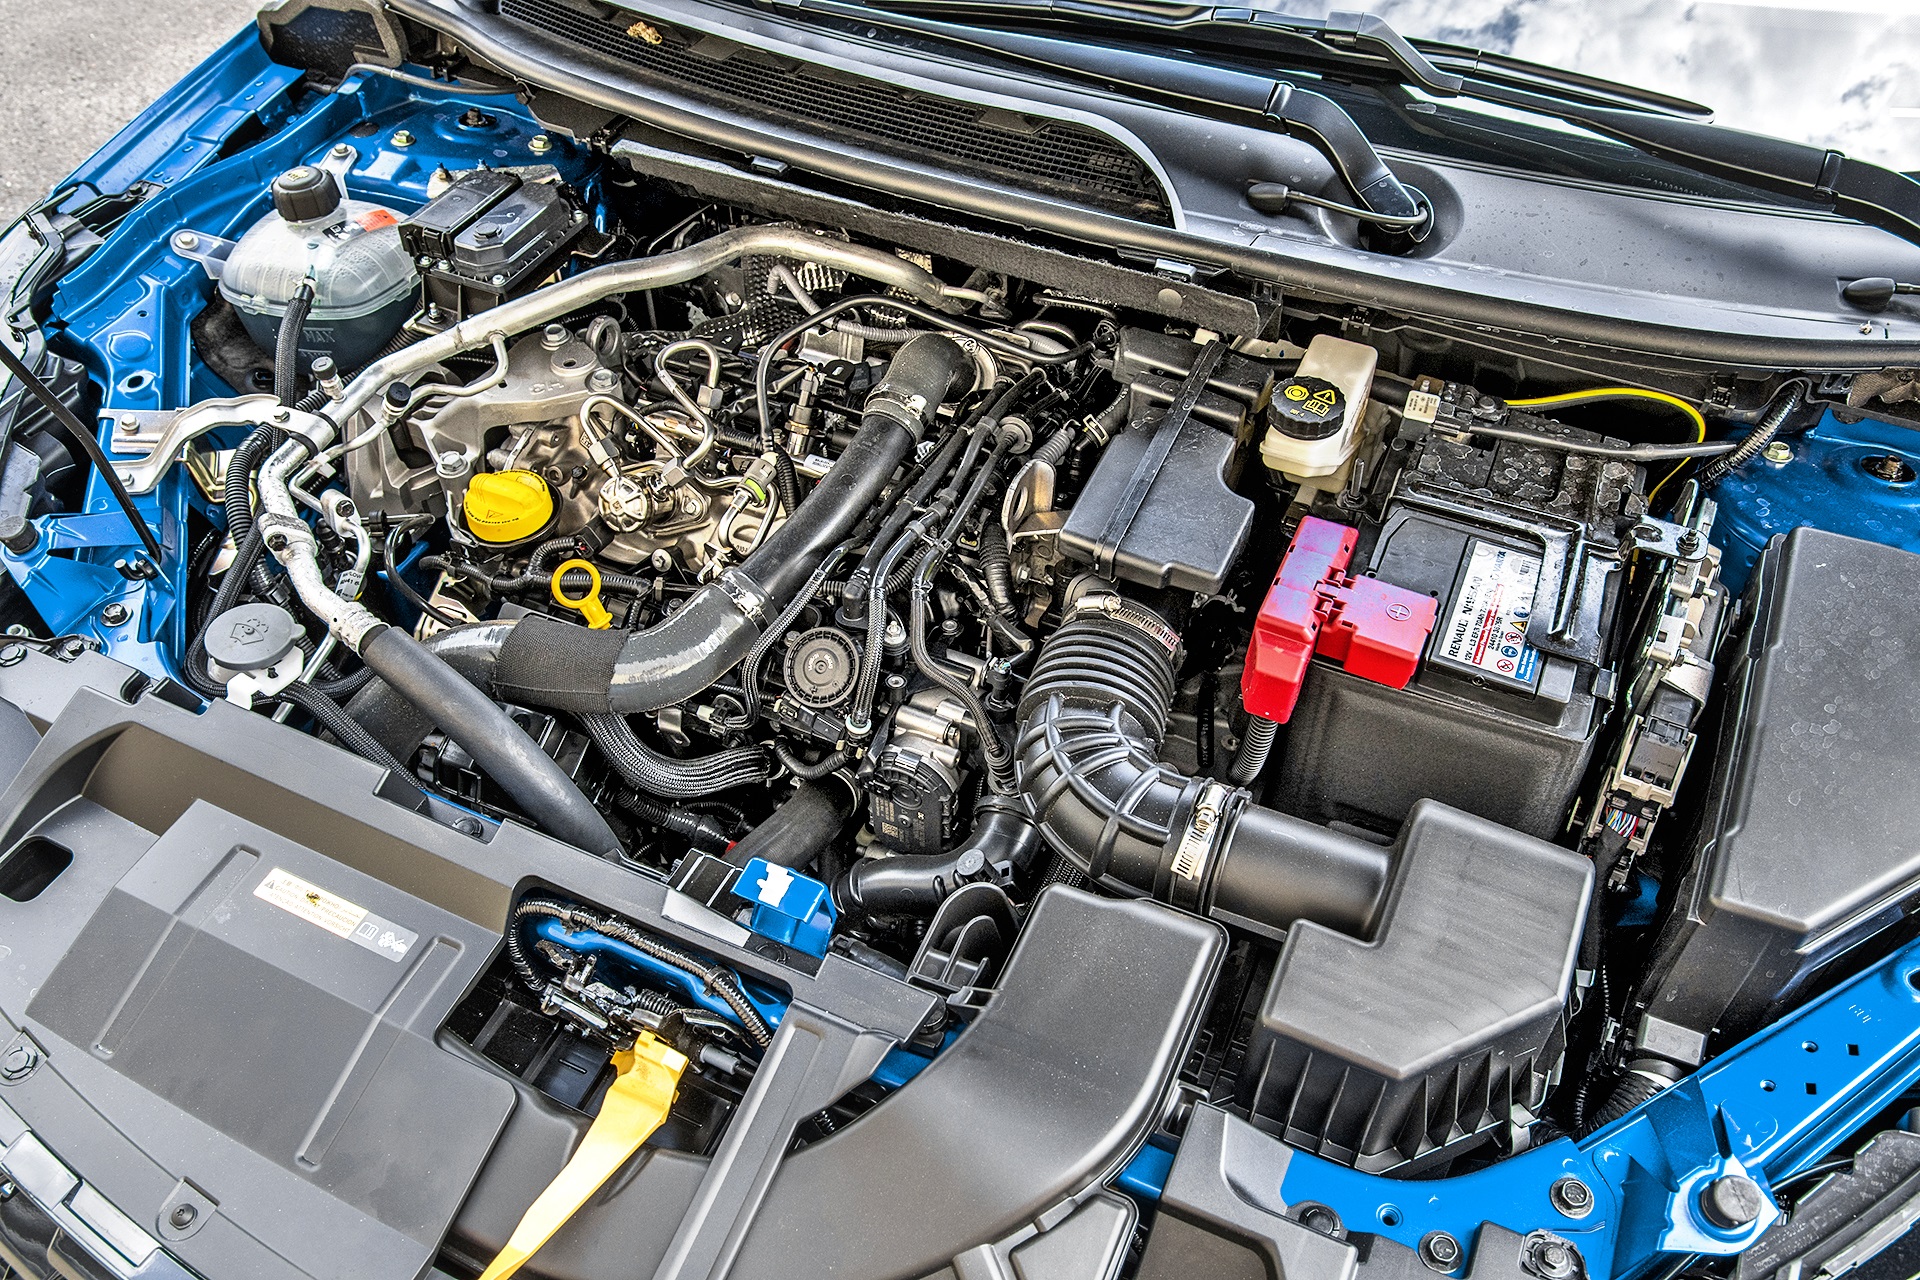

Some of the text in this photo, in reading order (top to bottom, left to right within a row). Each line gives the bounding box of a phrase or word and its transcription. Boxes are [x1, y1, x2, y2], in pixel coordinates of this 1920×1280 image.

[303, 330, 336, 343] MAX
[1493, 550, 1507, 572] VARTA
[275, 886, 298, 899] CAUTION
